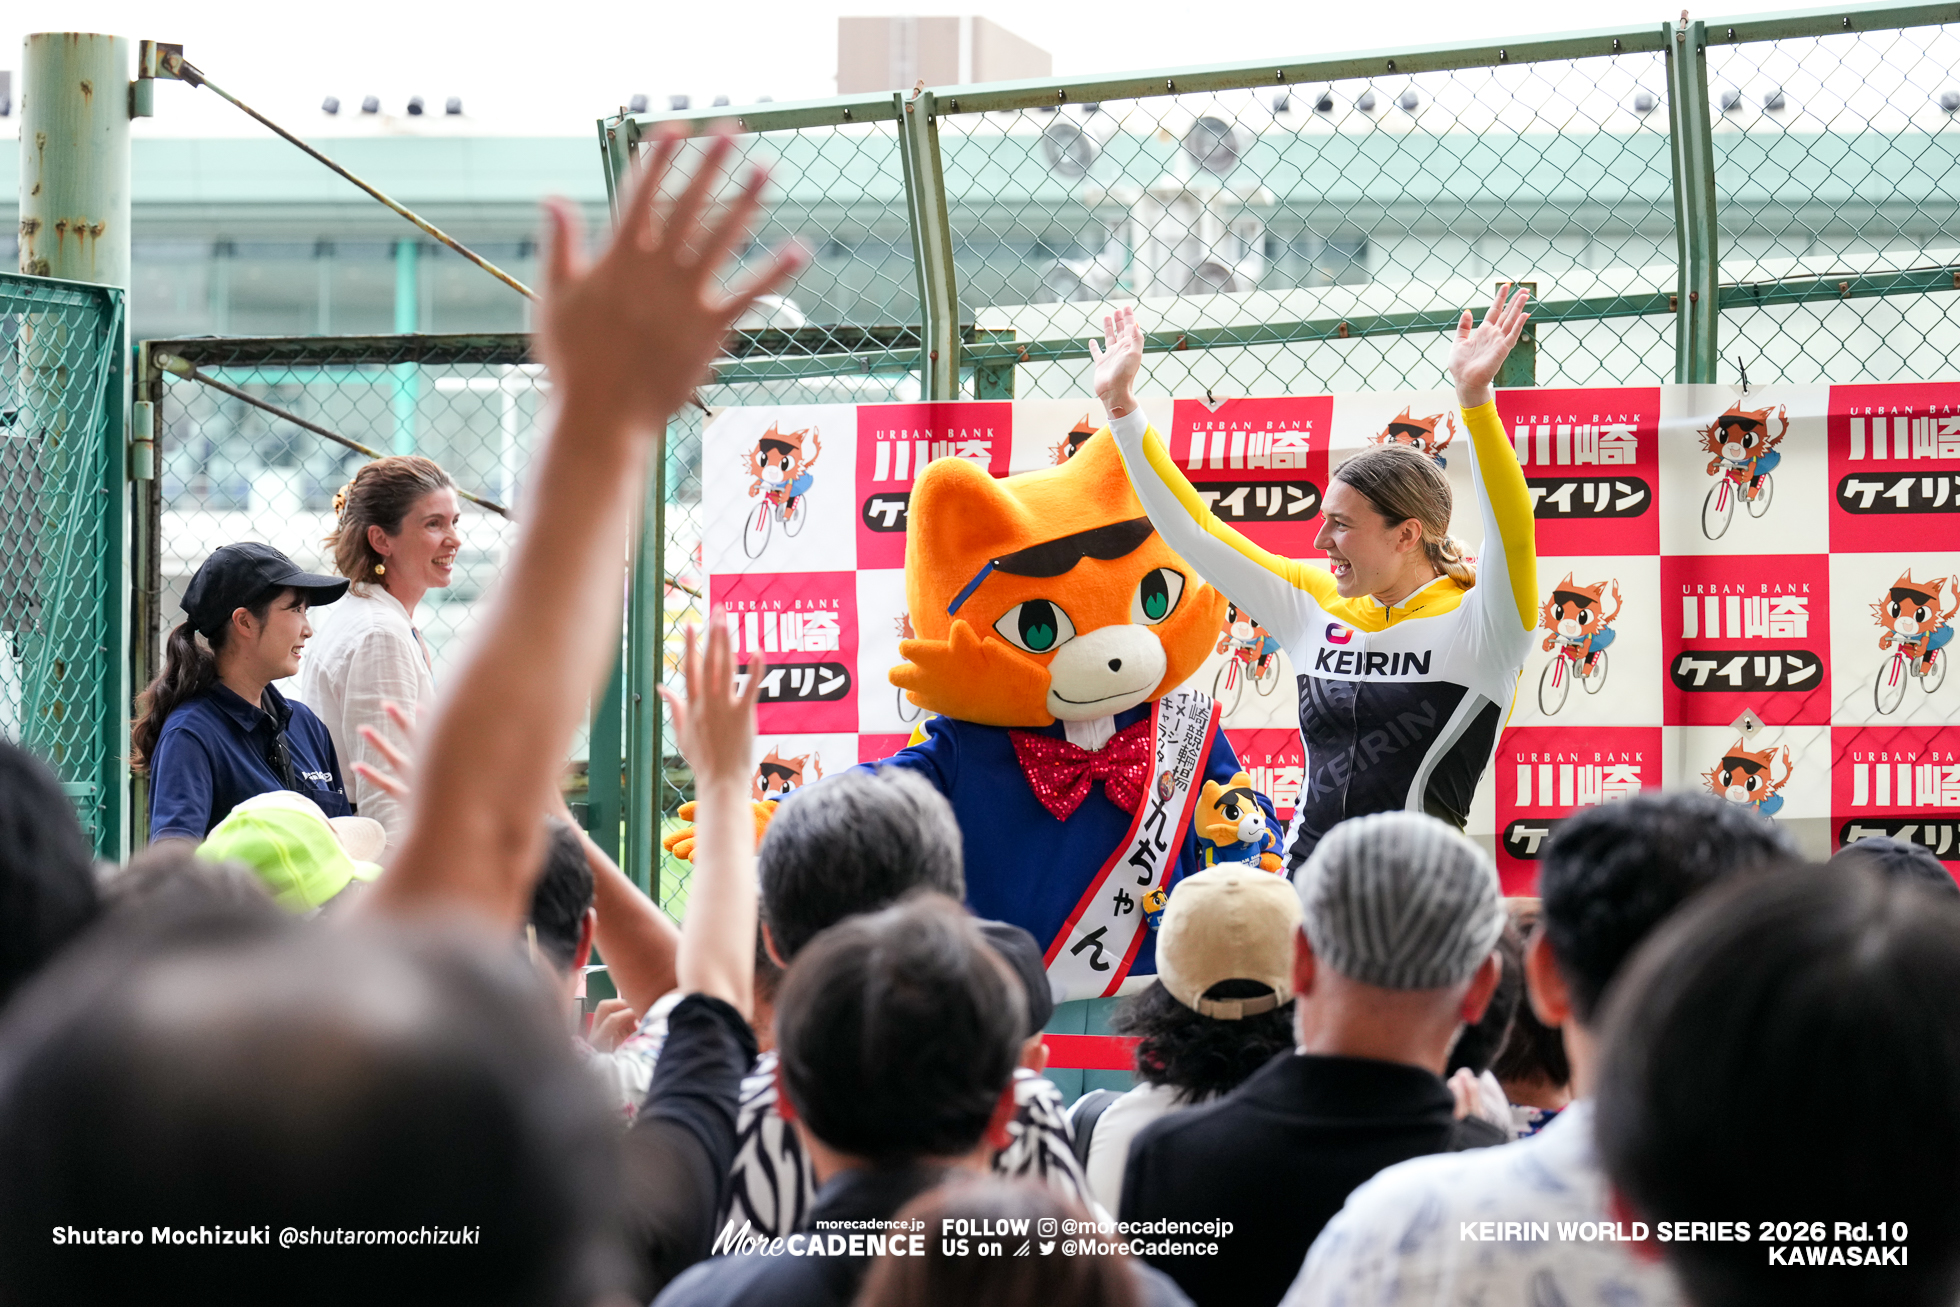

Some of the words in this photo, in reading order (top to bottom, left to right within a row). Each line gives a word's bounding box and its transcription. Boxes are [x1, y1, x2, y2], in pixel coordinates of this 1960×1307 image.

[1192, 421, 1252, 431] URBAN
[1266, 420, 1313, 430] BANK
[1516, 414, 1577, 425] URBAN
[1592, 413, 1641, 423] BANK
[1850, 405, 1913, 416] URBAN
[1929, 404, 1960, 414] BA
[876, 428, 933, 440] URBAN
[947, 427, 995, 438] BANK
[1514, 423, 1639, 466] 川崎
[1186, 430, 1311, 470] 川崎
[1843, 475, 1960, 508] ケイリ
[725, 600, 782, 611] URBAN
[794, 598, 840, 609] BANK
[1682, 583, 1745, 594] URBAN
[1760, 583, 1810, 593] BANK
[725, 610, 841, 653] 川崎
[1681, 595, 1810, 639] 川崎
[1314, 646, 1432, 676] KEIRIN
[1677, 654, 1817, 686] ケイリン
[1167, 693, 1190, 744] イメージ
[1156, 696, 1174, 777] キャラクター
[1172, 689, 1212, 792] 川崎競輪場
[1308, 699, 1438, 803] KEIRIN
[1265, 754, 1299, 764] BAN
[1516, 752, 1579, 763] URBAN
[1594, 752, 1643, 762] BANK
[1853, 751, 1917, 762] URBAN
[1932, 751, 1954, 761] BA
[1242, 766, 1304, 808] 崎
